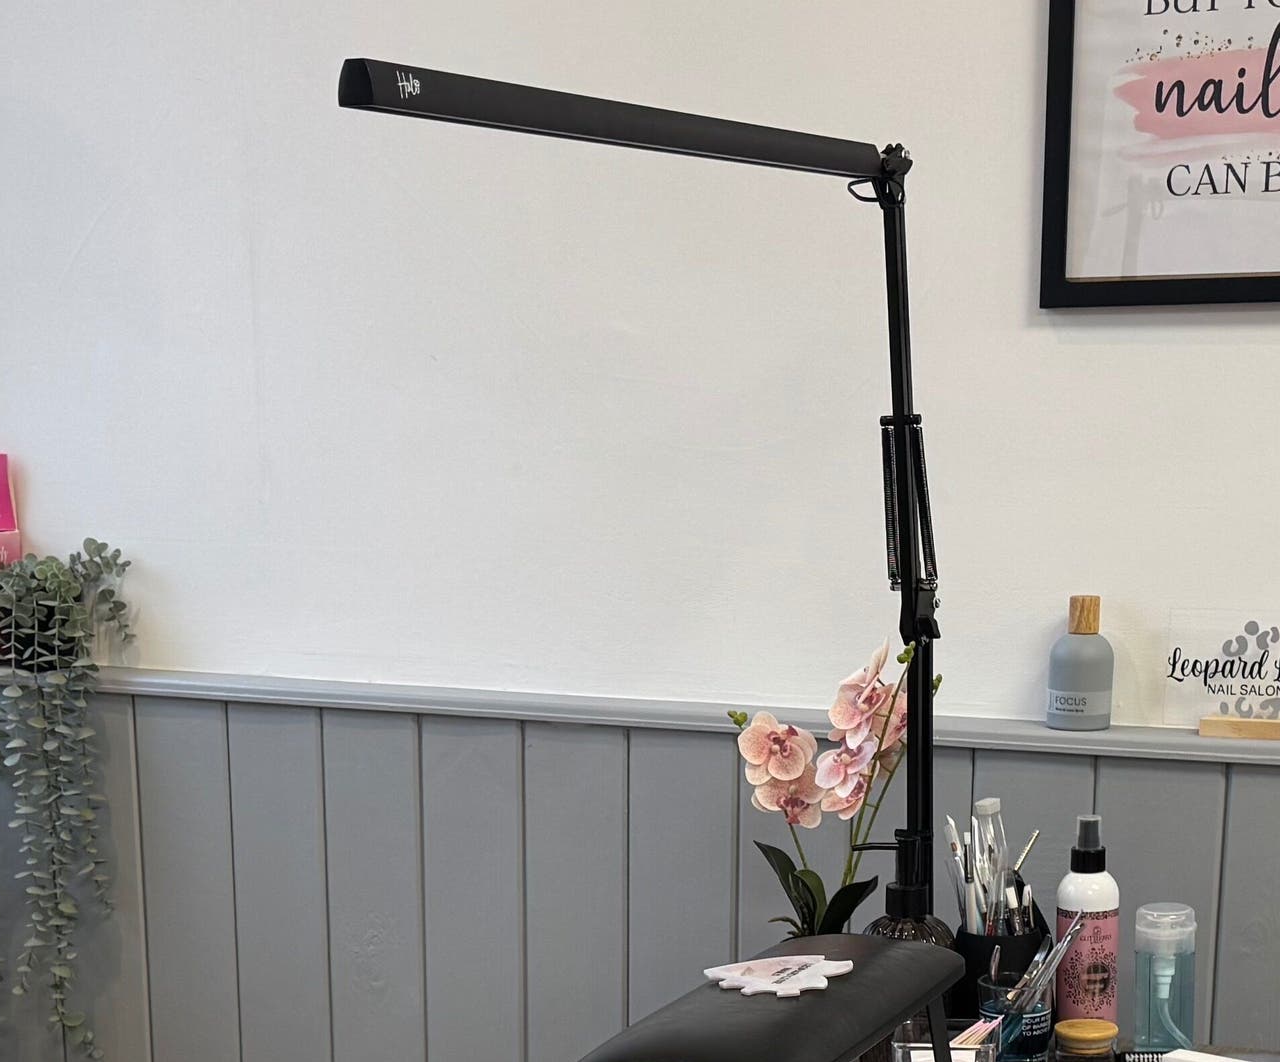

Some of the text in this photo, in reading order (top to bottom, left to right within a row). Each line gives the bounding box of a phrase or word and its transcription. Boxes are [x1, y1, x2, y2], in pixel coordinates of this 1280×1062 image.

[1166, 162, 1252, 197] CAN
[1166, 646, 1269, 687] Leopard
[1055, 695, 1087, 706] FOCUS
[1207, 684, 1237, 696] NAIL
